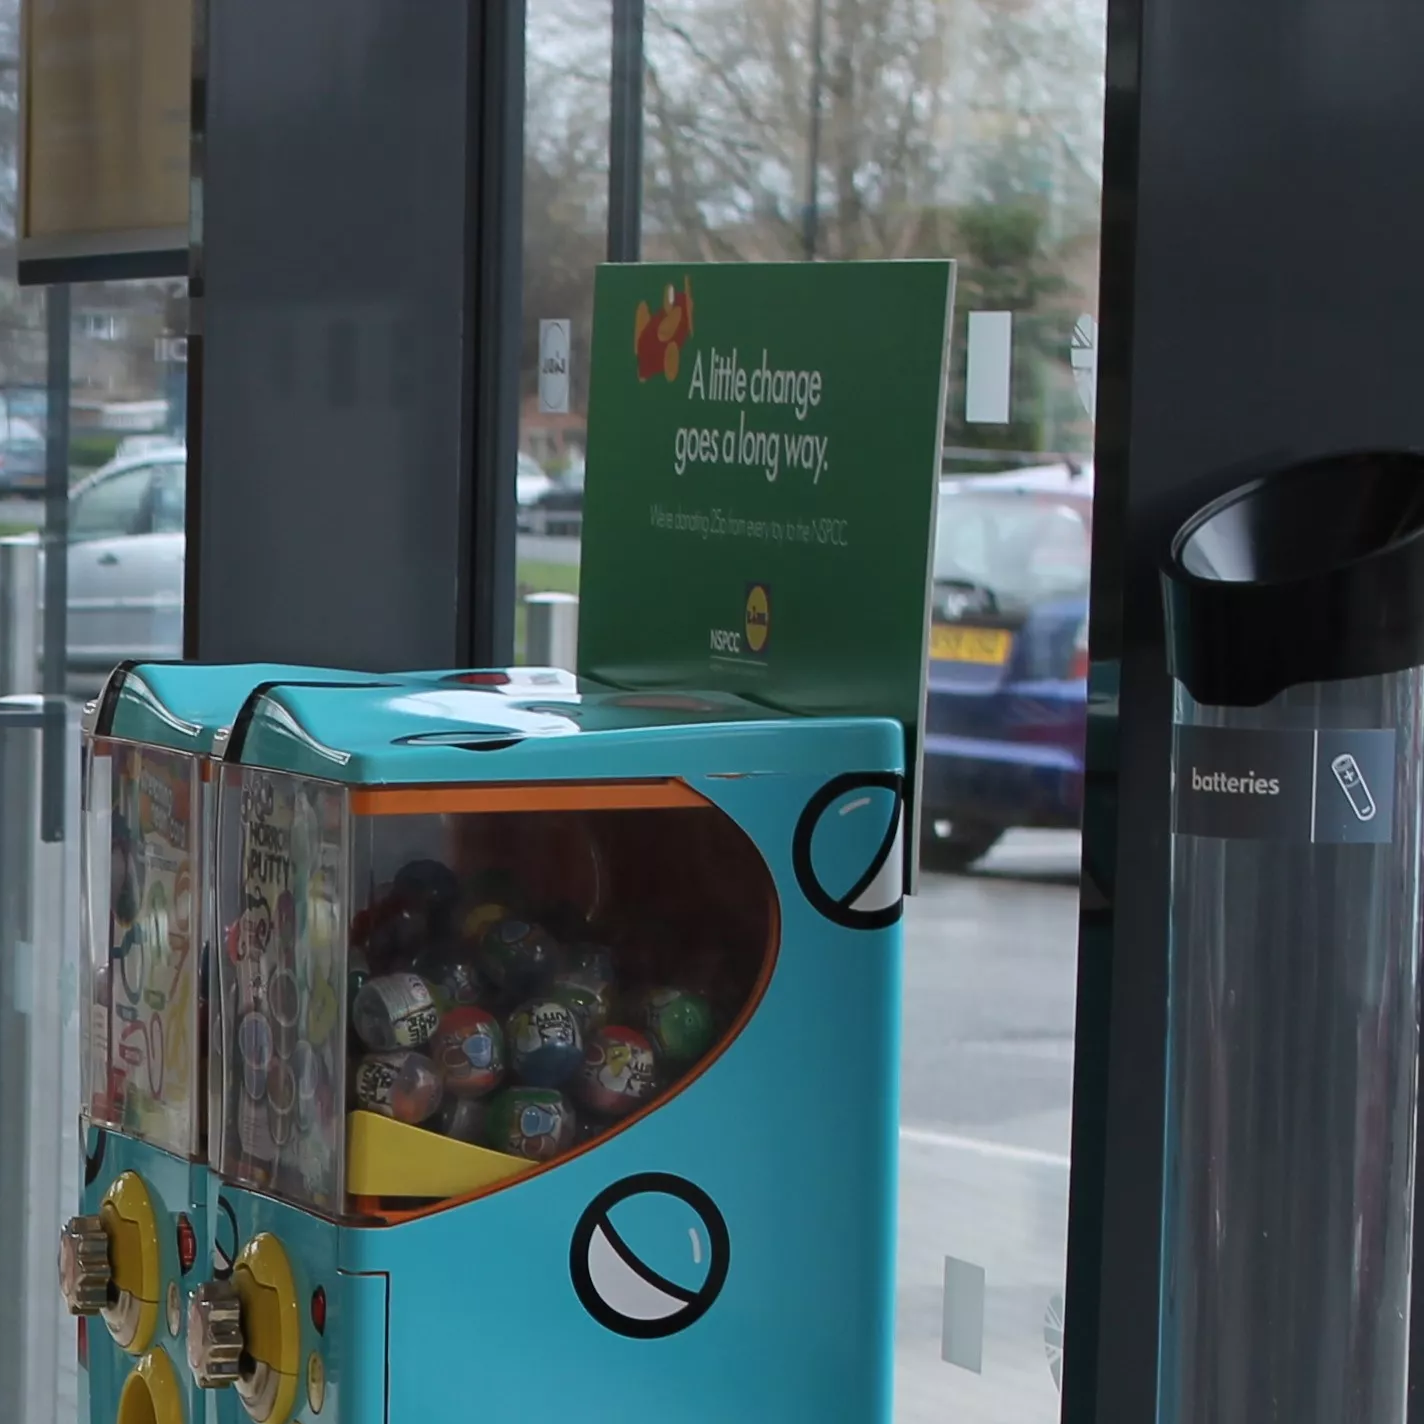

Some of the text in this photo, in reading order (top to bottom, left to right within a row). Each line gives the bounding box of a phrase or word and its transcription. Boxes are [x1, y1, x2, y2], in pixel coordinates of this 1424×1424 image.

[688, 347, 822, 421] A little change
[674, 410, 828, 485] goes a long way.
[710, 628, 740, 653] NSPCC
[1192, 766, 1280, 795] batteries
